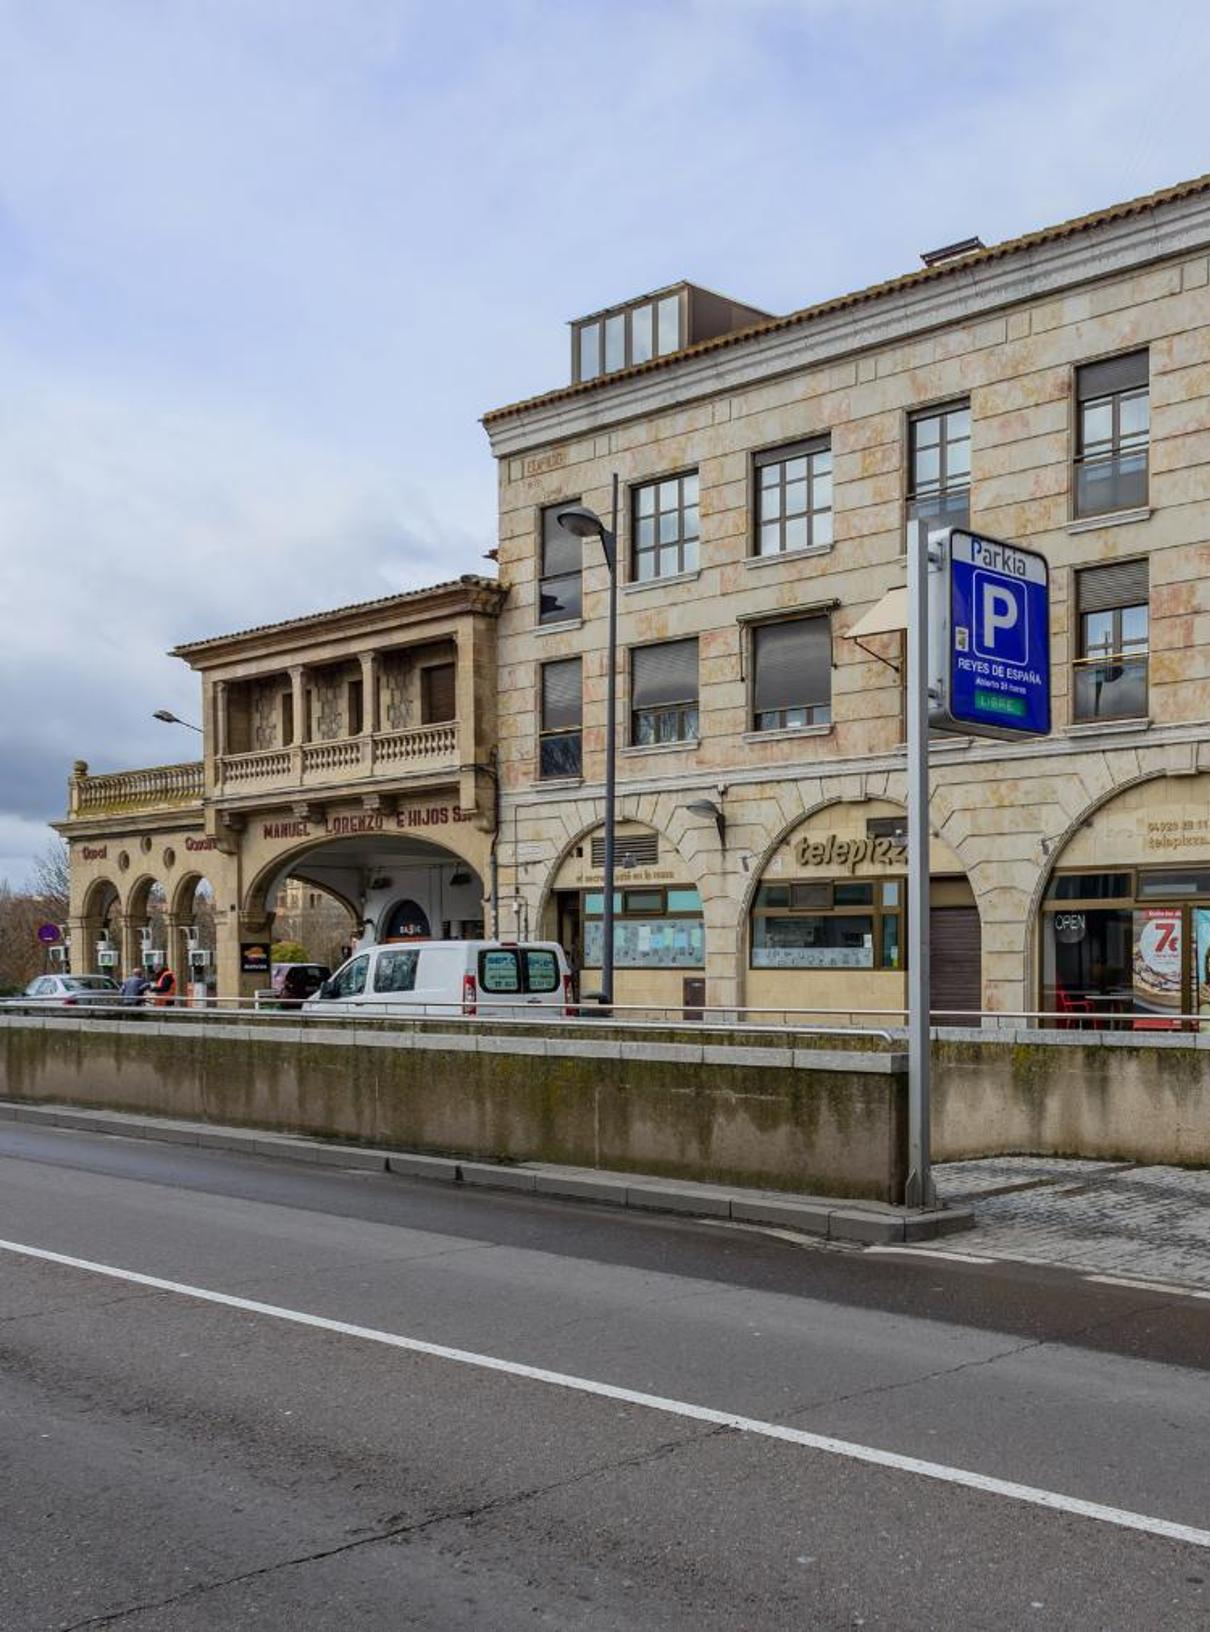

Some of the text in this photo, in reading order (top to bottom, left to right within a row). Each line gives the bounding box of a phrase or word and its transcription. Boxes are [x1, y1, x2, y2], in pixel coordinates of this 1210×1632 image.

[971, 537, 1026, 576] Parkia
[983, 582, 1018, 649] P
[957, 657, 1042, 685] REYES DE ESPAÑA
[976, 676, 1000, 689] Abierto
[980, 695, 1013, 712] LIBRE
[263, 822, 311, 840] MANUEL
[325, 813, 384, 834] LORENZO
[396, 811, 405, 828] E
[407, 807, 450, 827] HIJOS
[796, 833, 909, 875] telepizz
[1055, 914, 1085, 930] OPEN
[1155, 922, 1178, 952] 7€
